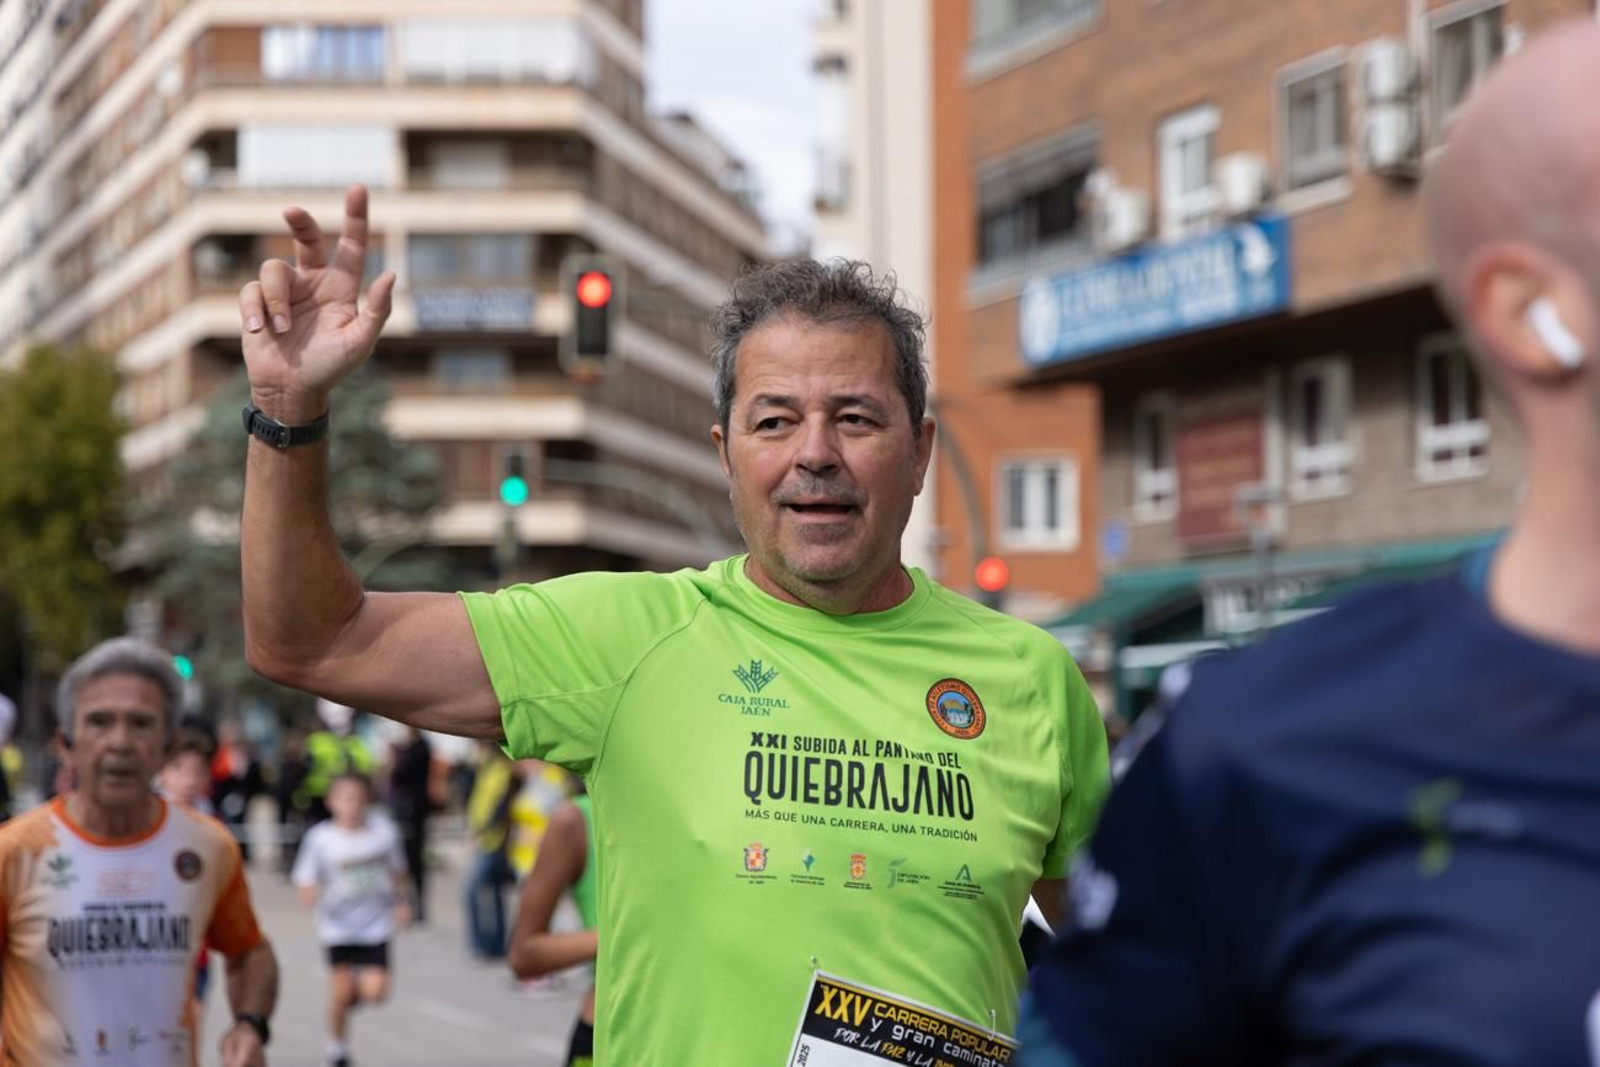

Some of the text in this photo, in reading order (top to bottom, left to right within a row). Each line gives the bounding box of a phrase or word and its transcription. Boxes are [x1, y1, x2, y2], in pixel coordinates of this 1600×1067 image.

[718, 693, 790, 709] CAJA RURAL
[750, 732, 787, 749] XXI
[793, 735, 847, 756] SUBIDA
[852, 739, 870, 757] AL
[938, 752, 962, 769] DEL
[744, 750, 974, 821] QUIEBRAJANO
[745, 808, 977, 842] MÁS QUE UNA CARRERA, UNA TRADICIÓN
[815, 983, 1011, 1063] XXV CARRERA POPULAR
[833, 1027, 861, 1044] POR
[860, 1036, 881, 1052] LA
[880, 1042, 907, 1059] PAZ
[914, 1053, 933, 1067] LA
[892, 1024, 935, 1049] gran
[943, 1041, 1005, 1067] caminat
